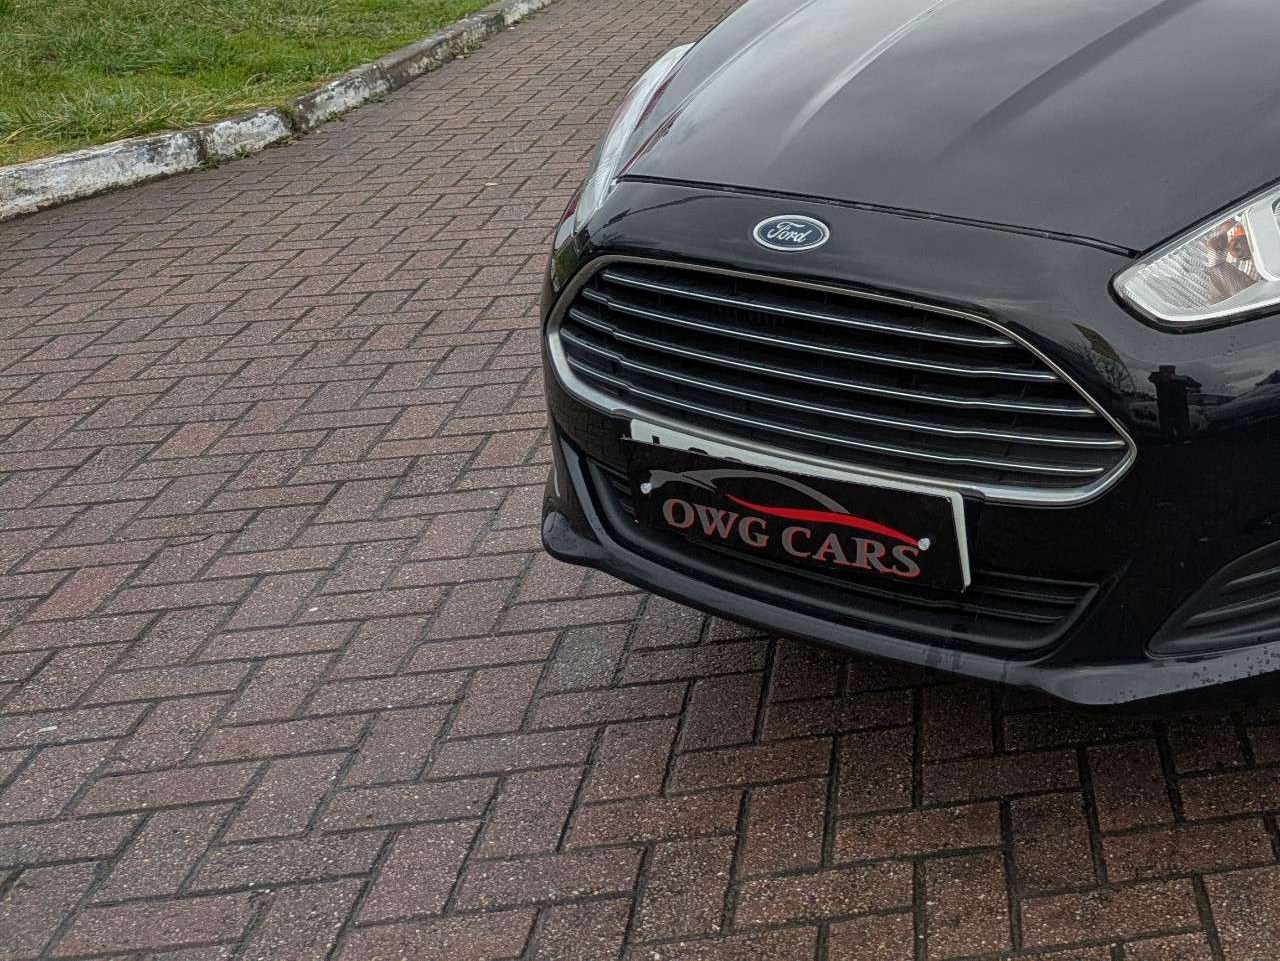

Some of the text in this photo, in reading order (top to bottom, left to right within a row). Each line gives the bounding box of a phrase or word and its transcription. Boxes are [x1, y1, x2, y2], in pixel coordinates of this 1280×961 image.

[766, 221, 813, 244] Ford
[661, 497, 922, 579] OWG CARS
